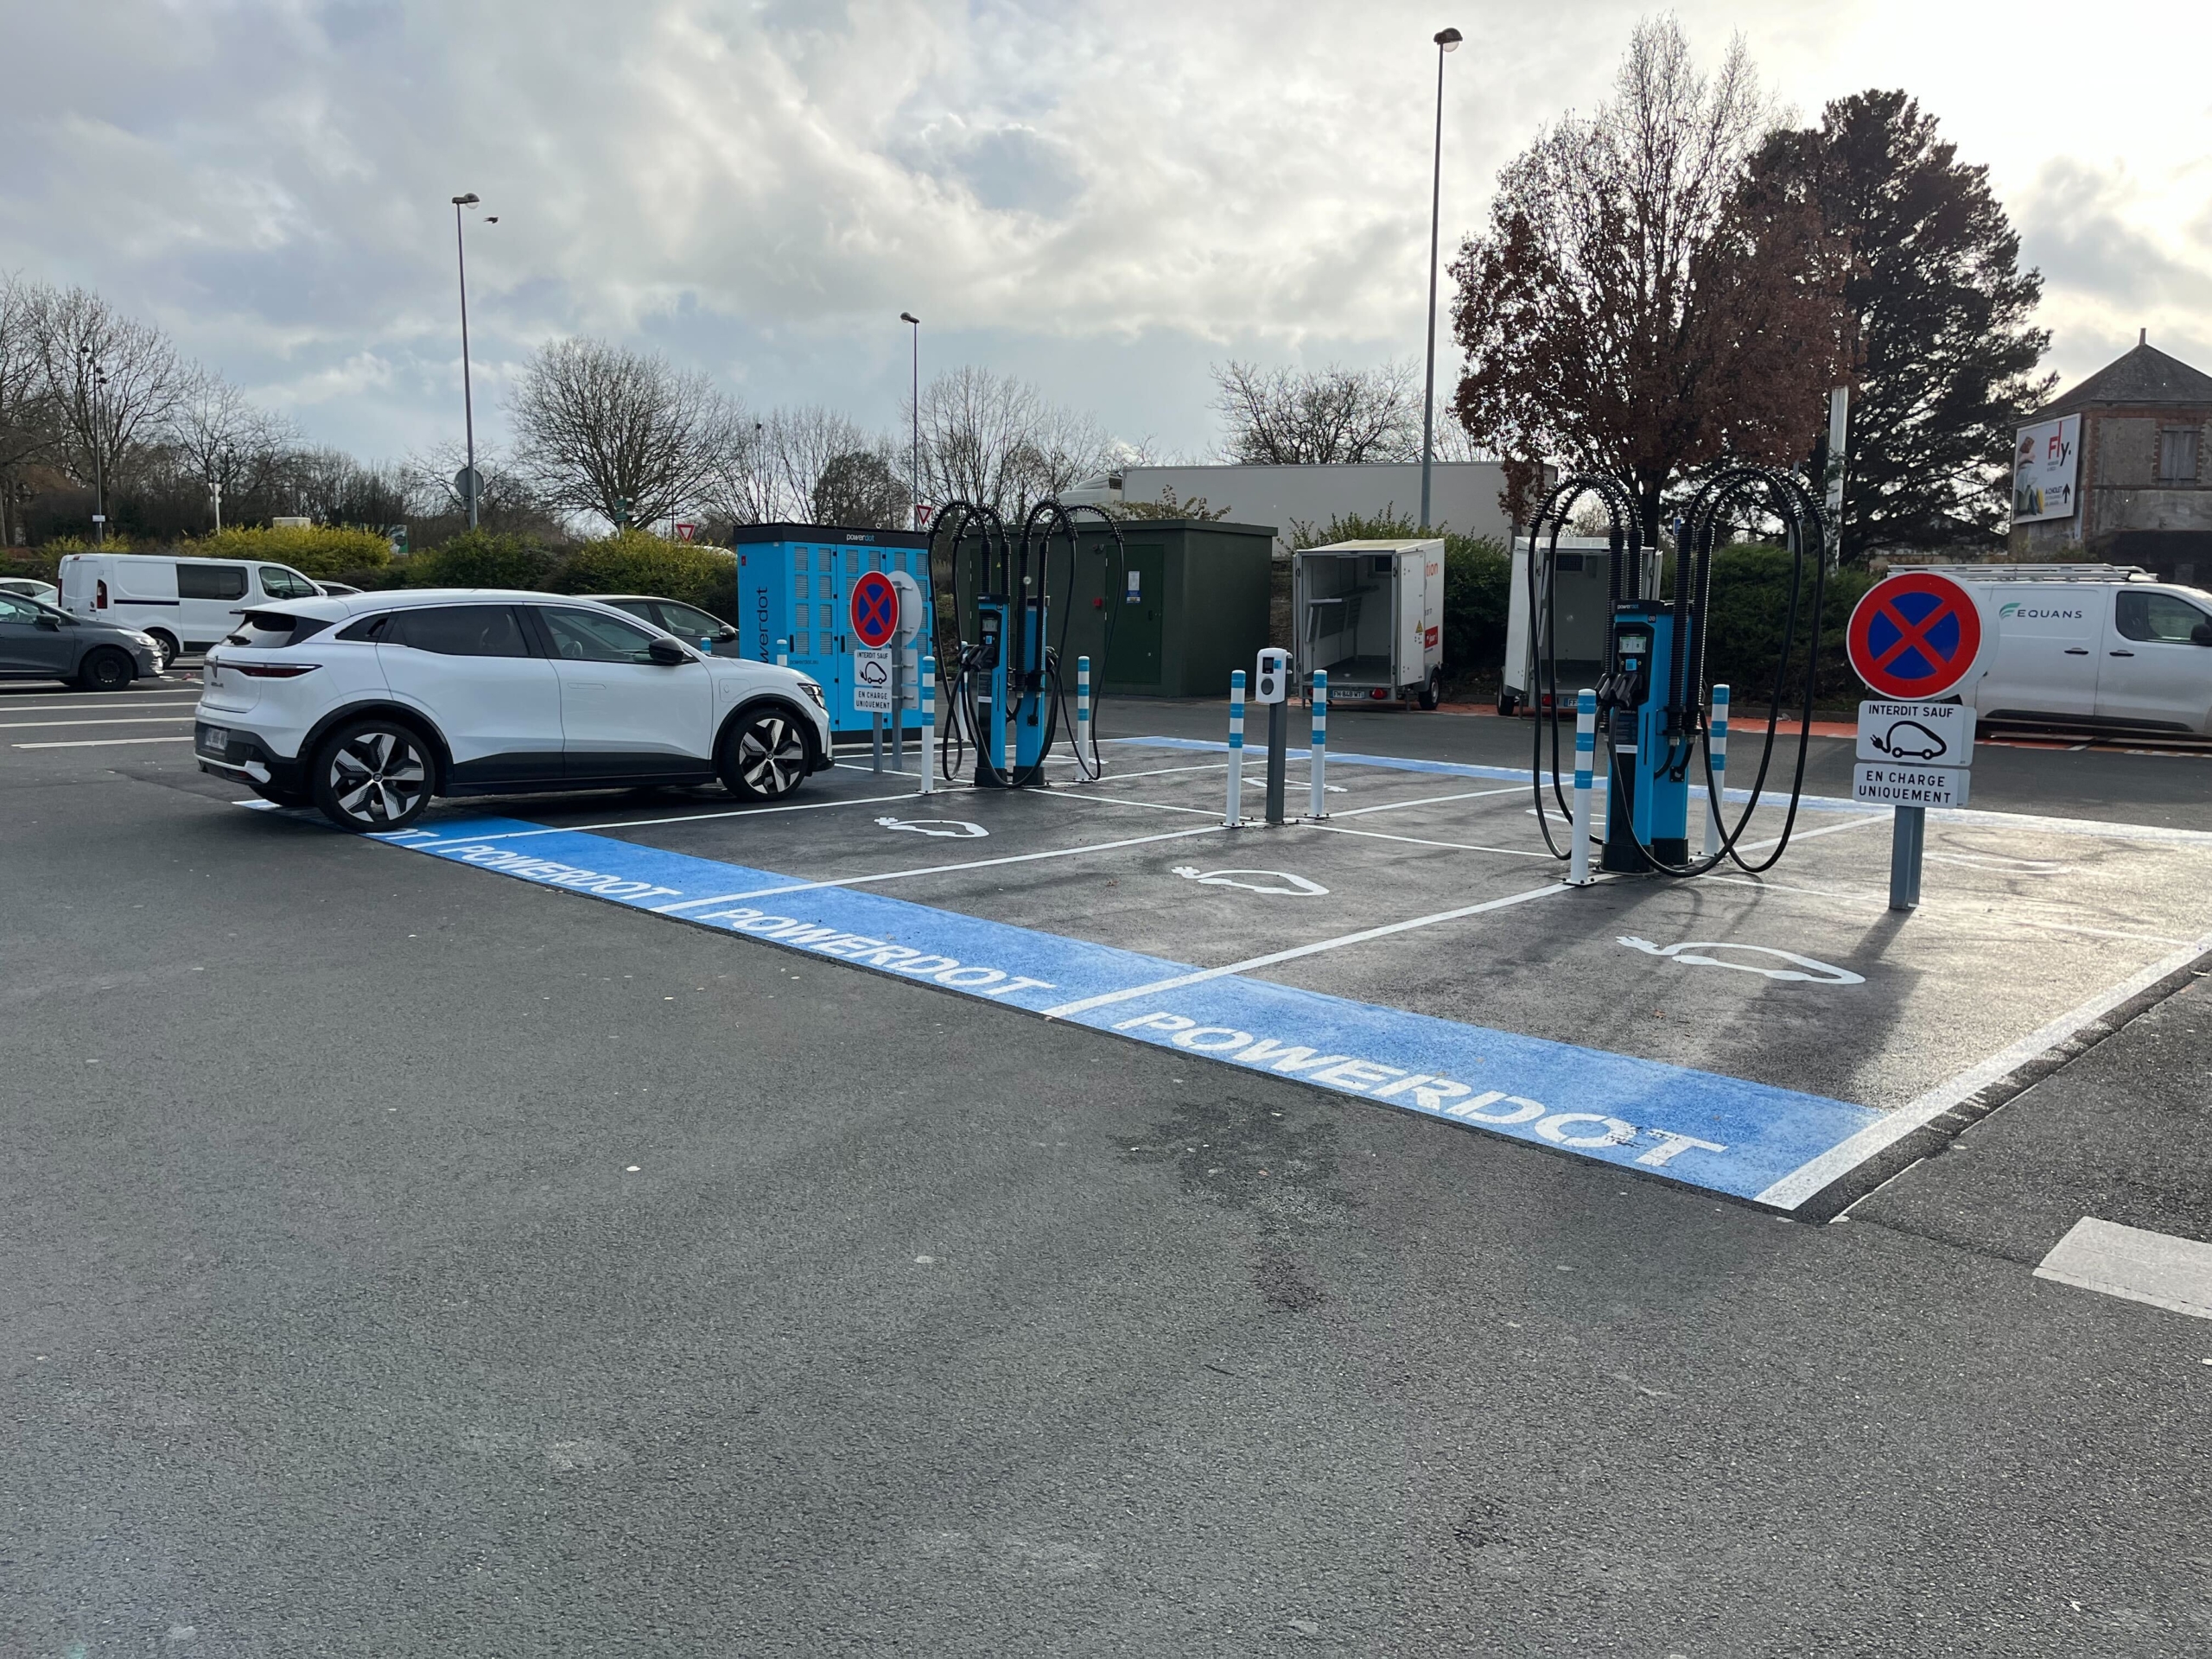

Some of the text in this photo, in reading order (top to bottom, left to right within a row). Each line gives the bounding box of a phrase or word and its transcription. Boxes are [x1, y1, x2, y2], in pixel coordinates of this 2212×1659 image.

[1426, 561, 1439, 577] tion
[2017, 608, 2083, 620] EQUANS
[756, 586, 769, 664] werdot
[855, 700, 891, 709] UNIQUEMENT
[867, 691, 888, 700] CHARGE
[1868, 704, 1955, 718] INTERDIT SAUF
[1866, 770, 1946, 788] EN CHARGE
[1859, 785, 1951, 804] UNIQUEMENT
[436, 844, 684, 900] POWERDOT
[694, 907, 1058, 995] POWERDOT
[1111, 1011, 1730, 1167] POWERDOT
